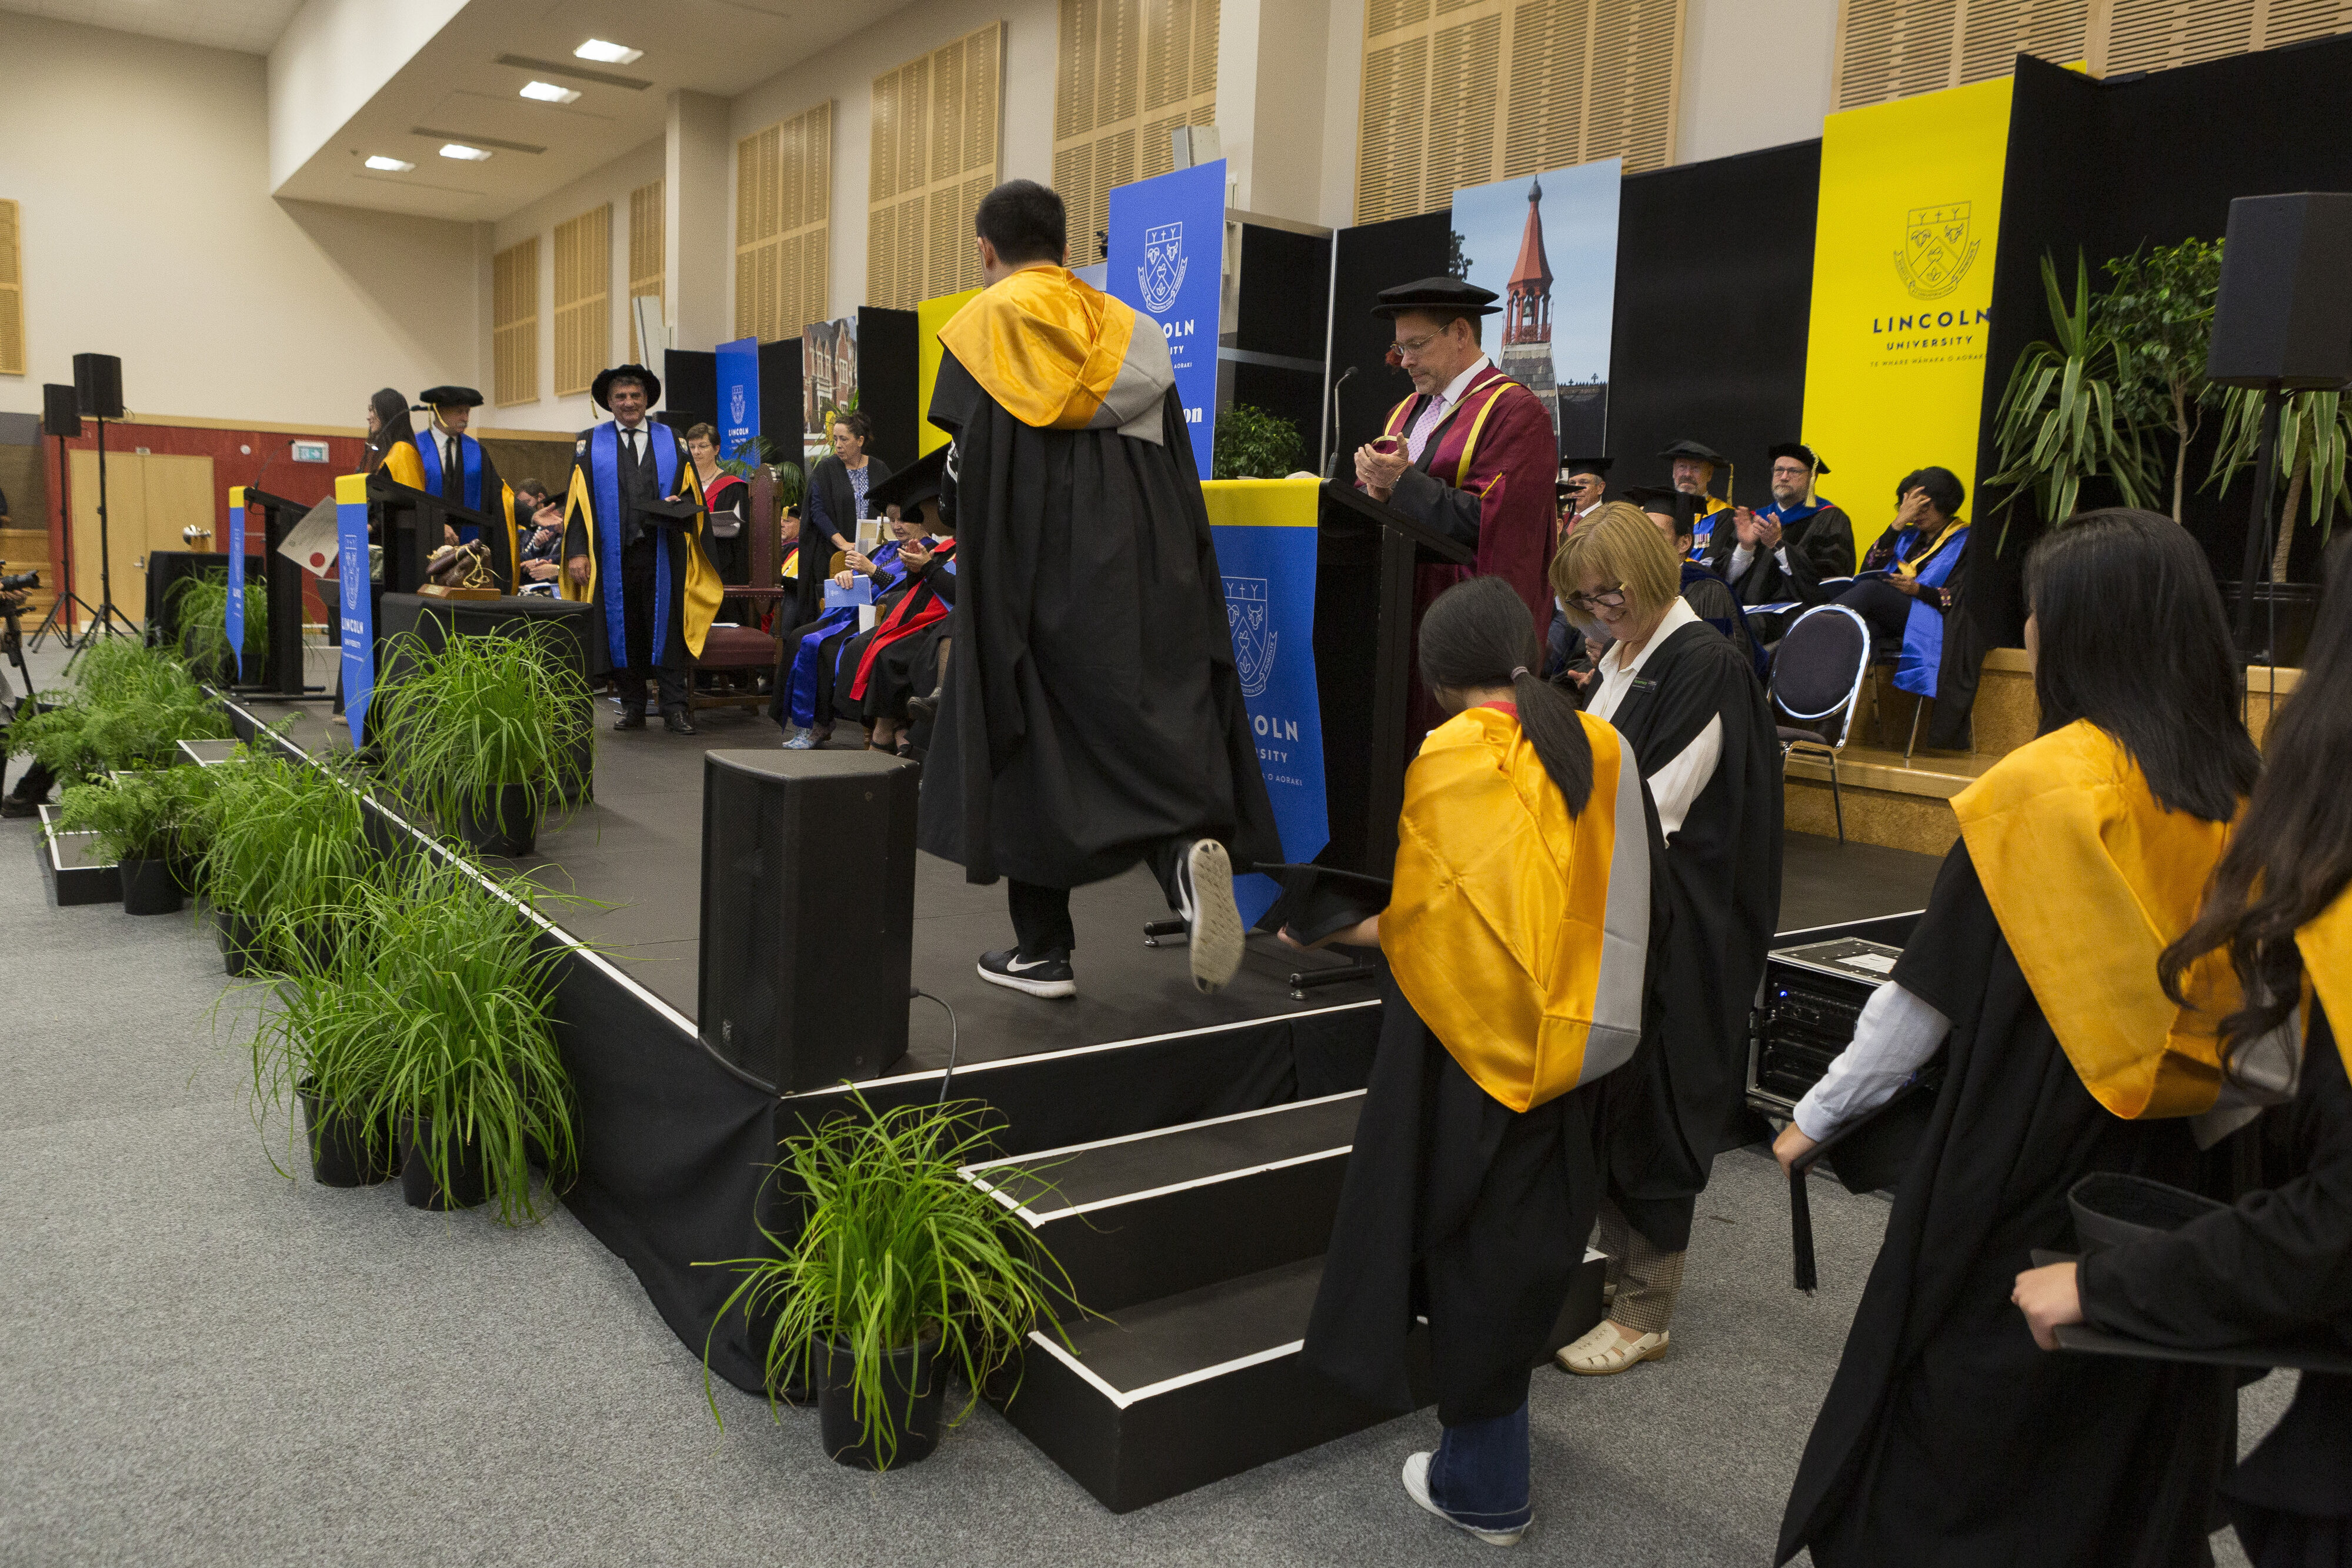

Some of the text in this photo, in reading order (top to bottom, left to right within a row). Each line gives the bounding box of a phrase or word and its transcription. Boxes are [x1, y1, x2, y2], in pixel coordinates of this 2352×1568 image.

[1873, 306, 1991, 333] LINCOLN
[1886, 335, 1973, 351] UNIVERSITY
[1276, 775, 1302, 786] AORAKI
